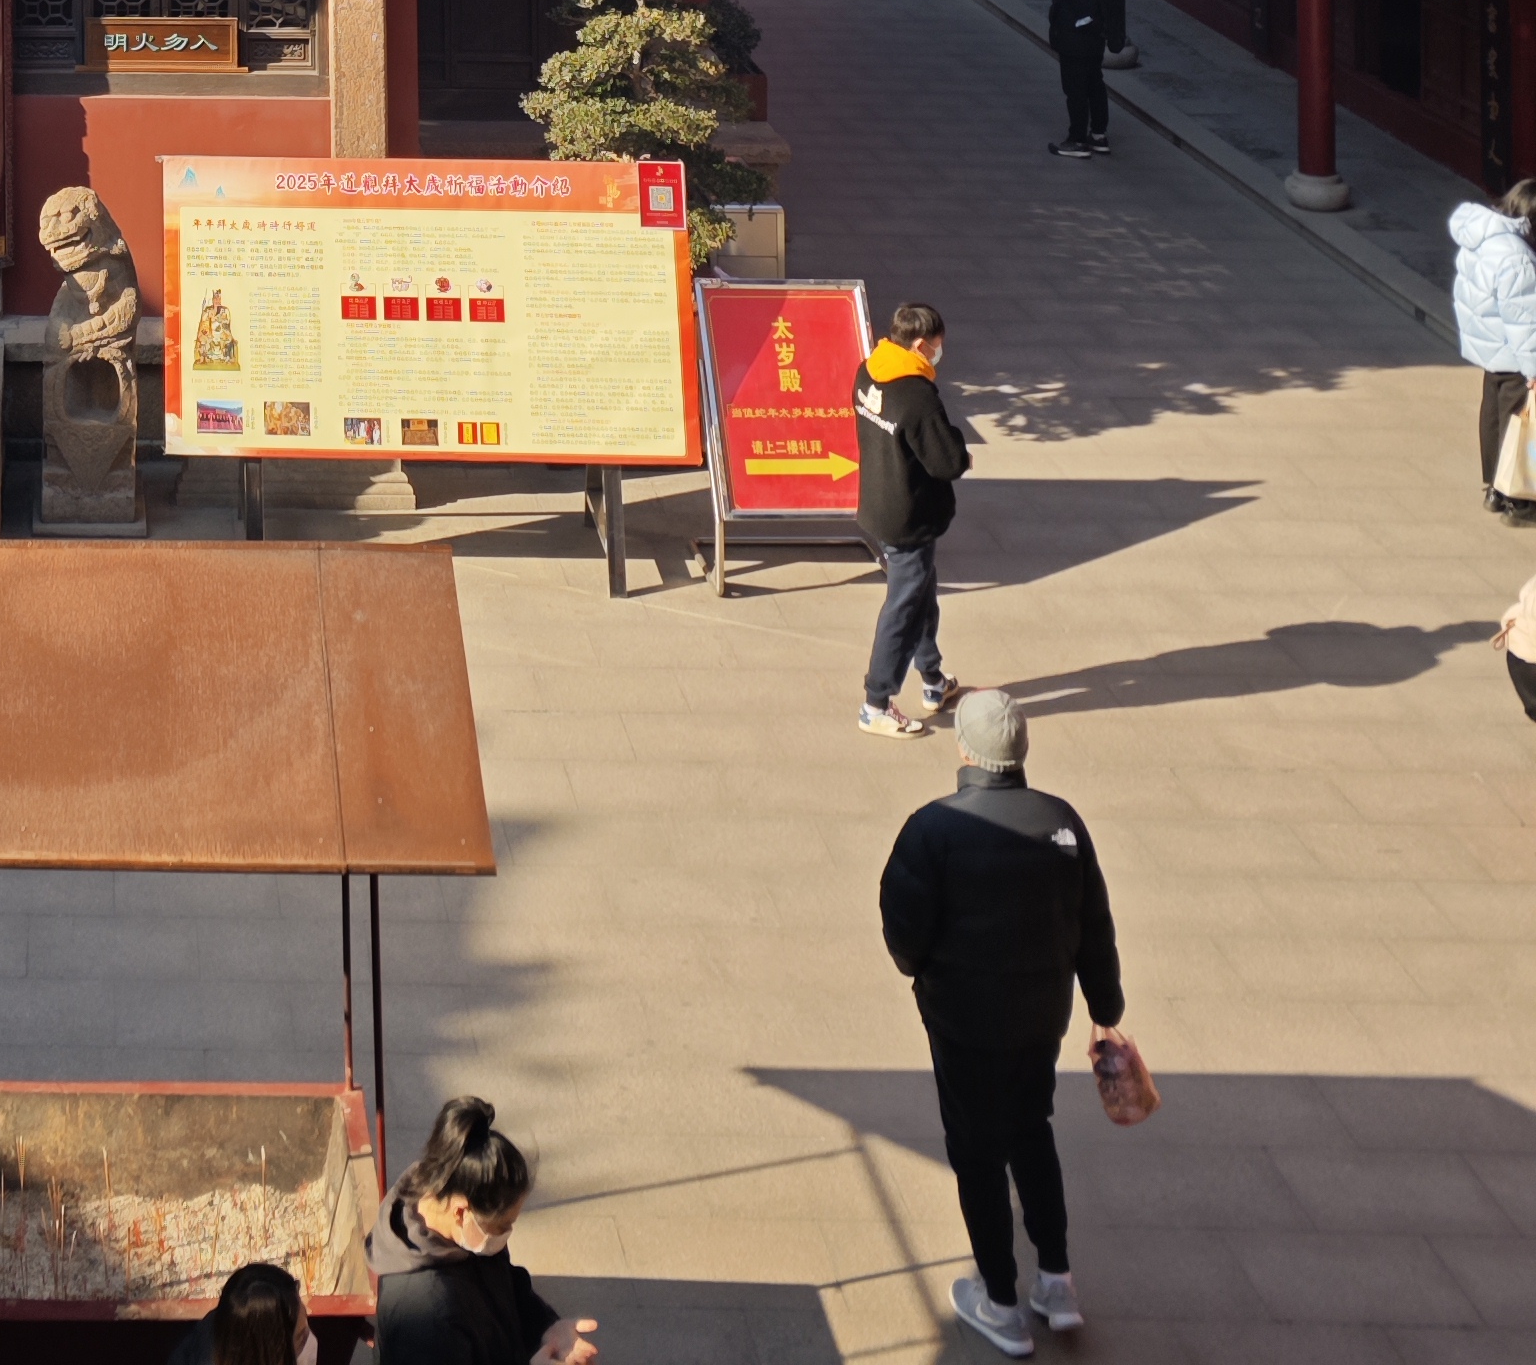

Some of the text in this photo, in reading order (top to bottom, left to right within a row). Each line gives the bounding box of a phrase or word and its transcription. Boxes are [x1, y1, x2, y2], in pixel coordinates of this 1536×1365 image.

[103, 32, 220, 53] 明火勿入
[771, 316, 803, 393] 太岁殿
[751, 440, 823, 455] 请上二楼礼拜
